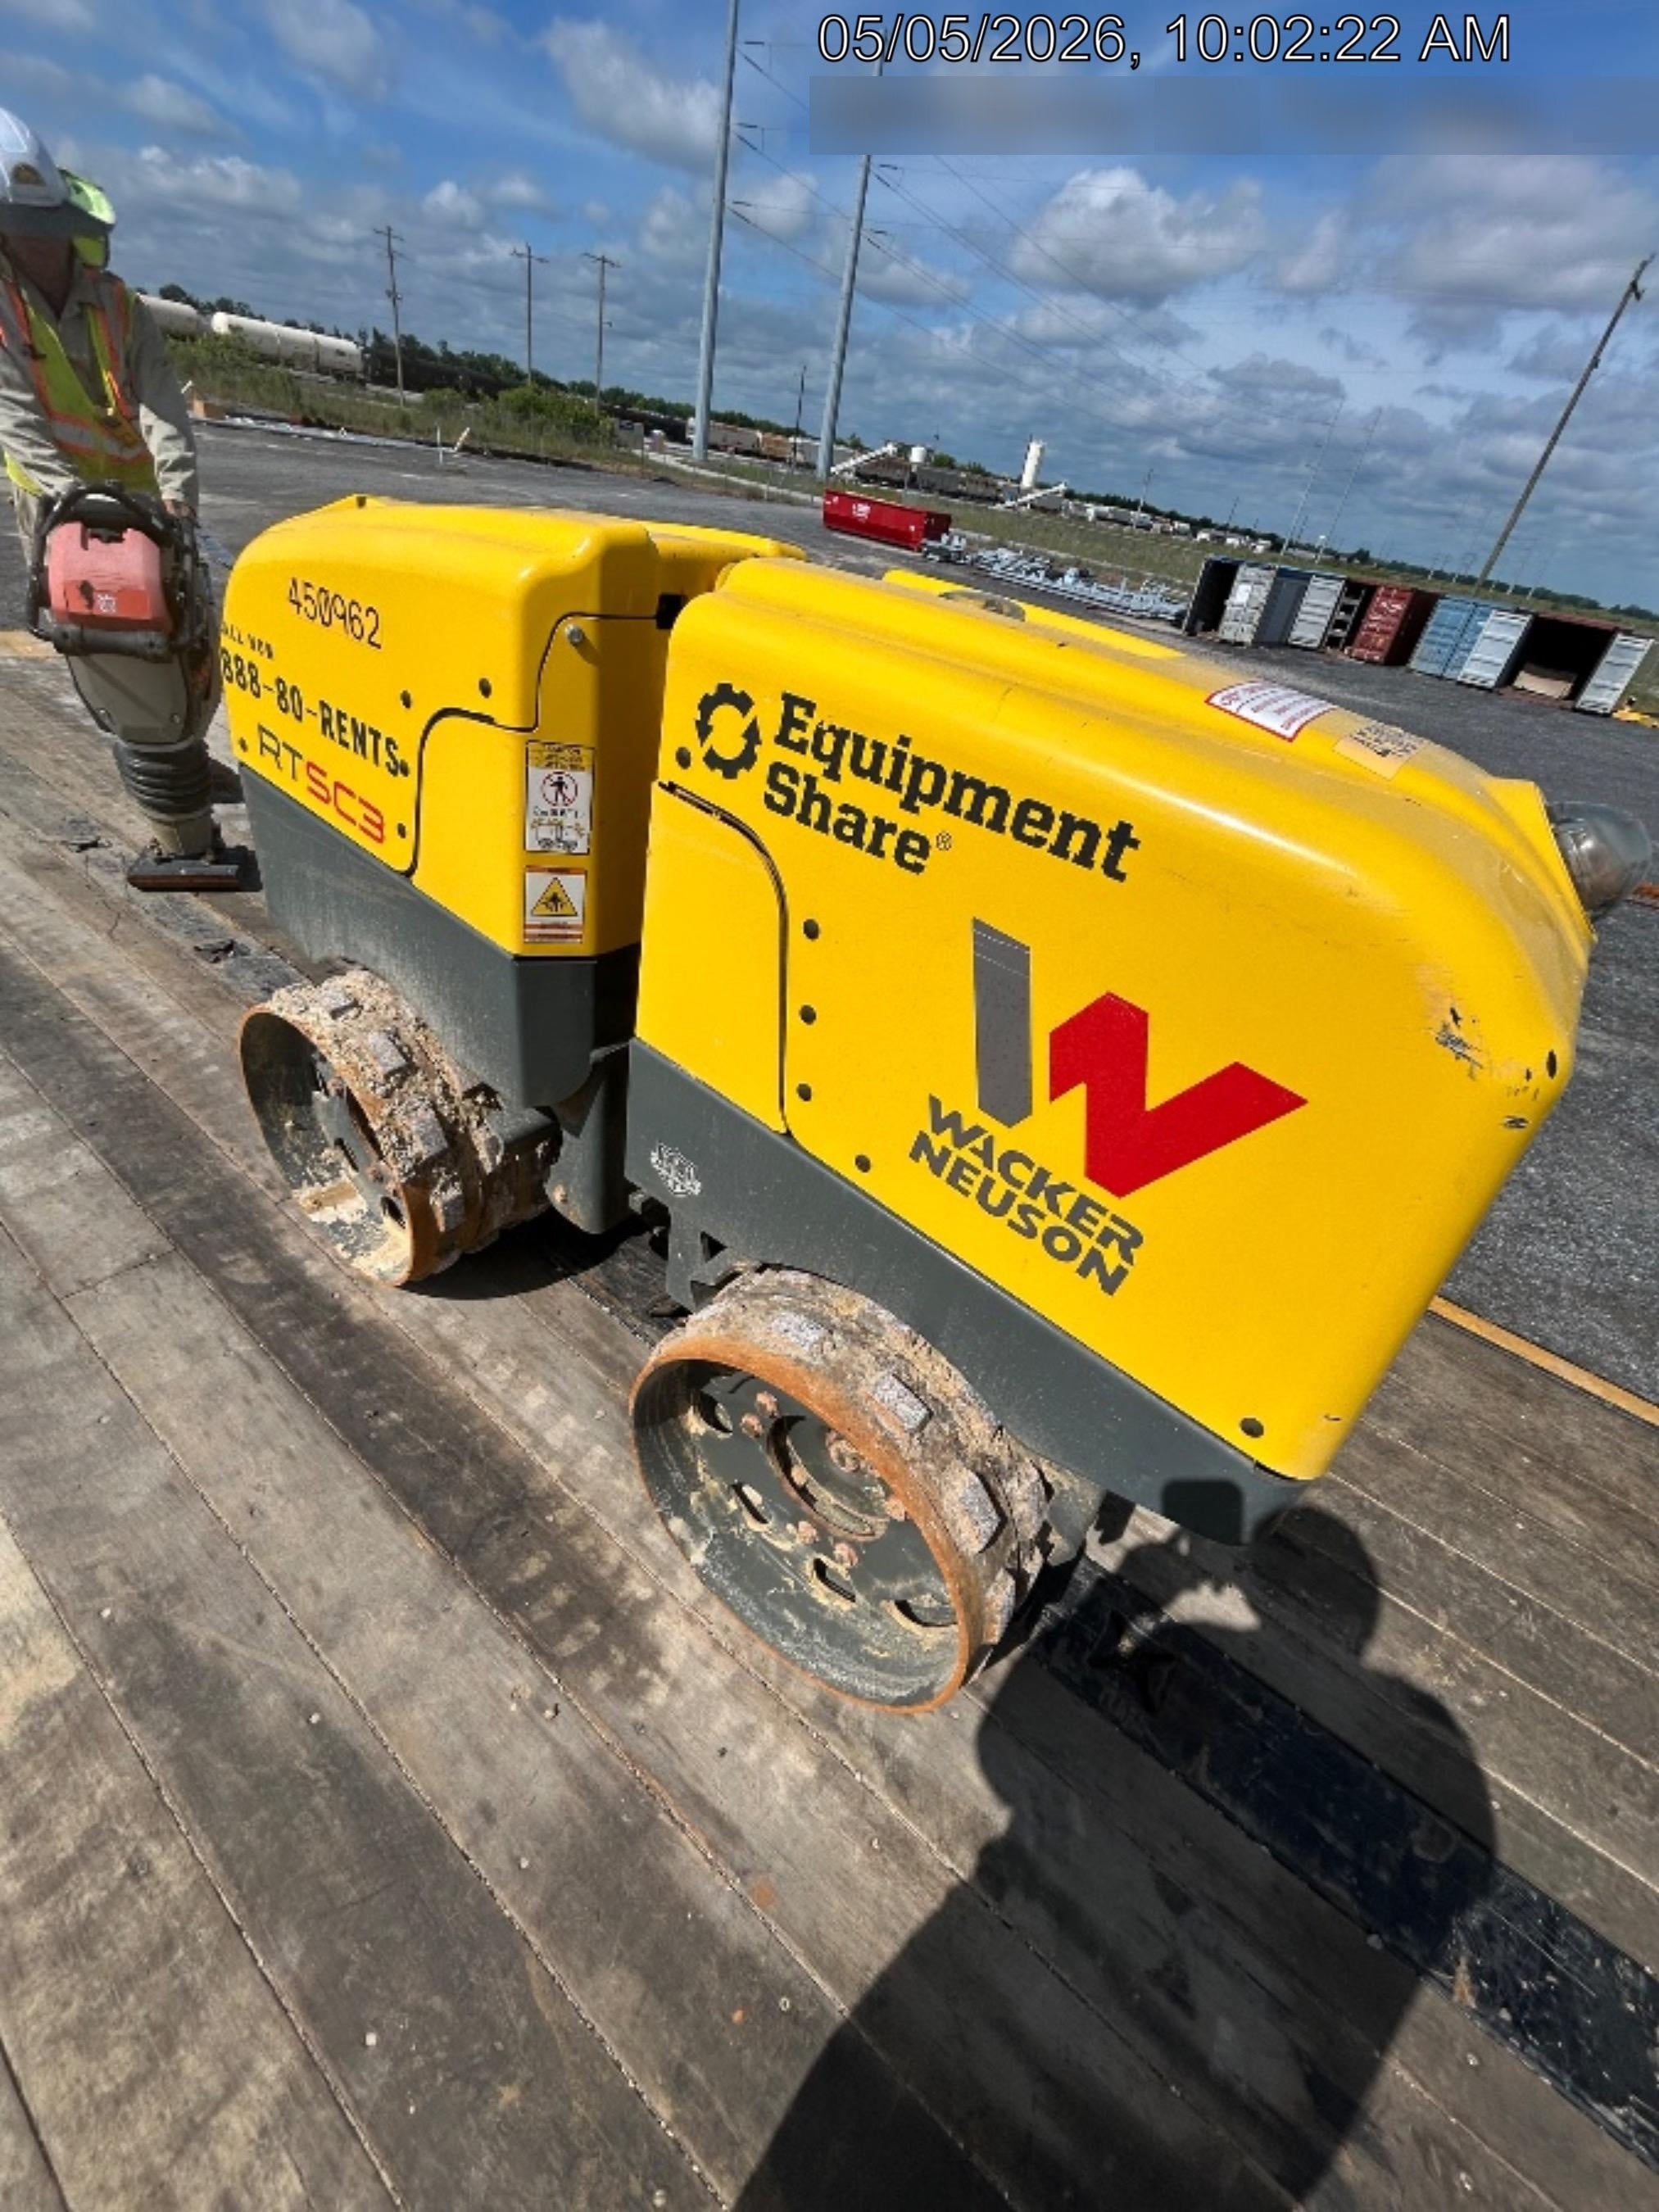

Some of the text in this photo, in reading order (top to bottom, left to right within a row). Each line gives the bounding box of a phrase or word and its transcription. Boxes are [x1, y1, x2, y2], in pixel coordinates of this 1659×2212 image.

[288, 576, 382, 649] 450962
[257, 723, 385, 844] RTSC3
[773, 691, 1140, 883] Equipment
[909, 1130, 1129, 1296] NEUSON
[928, 1092, 1145, 1267] WACKER
